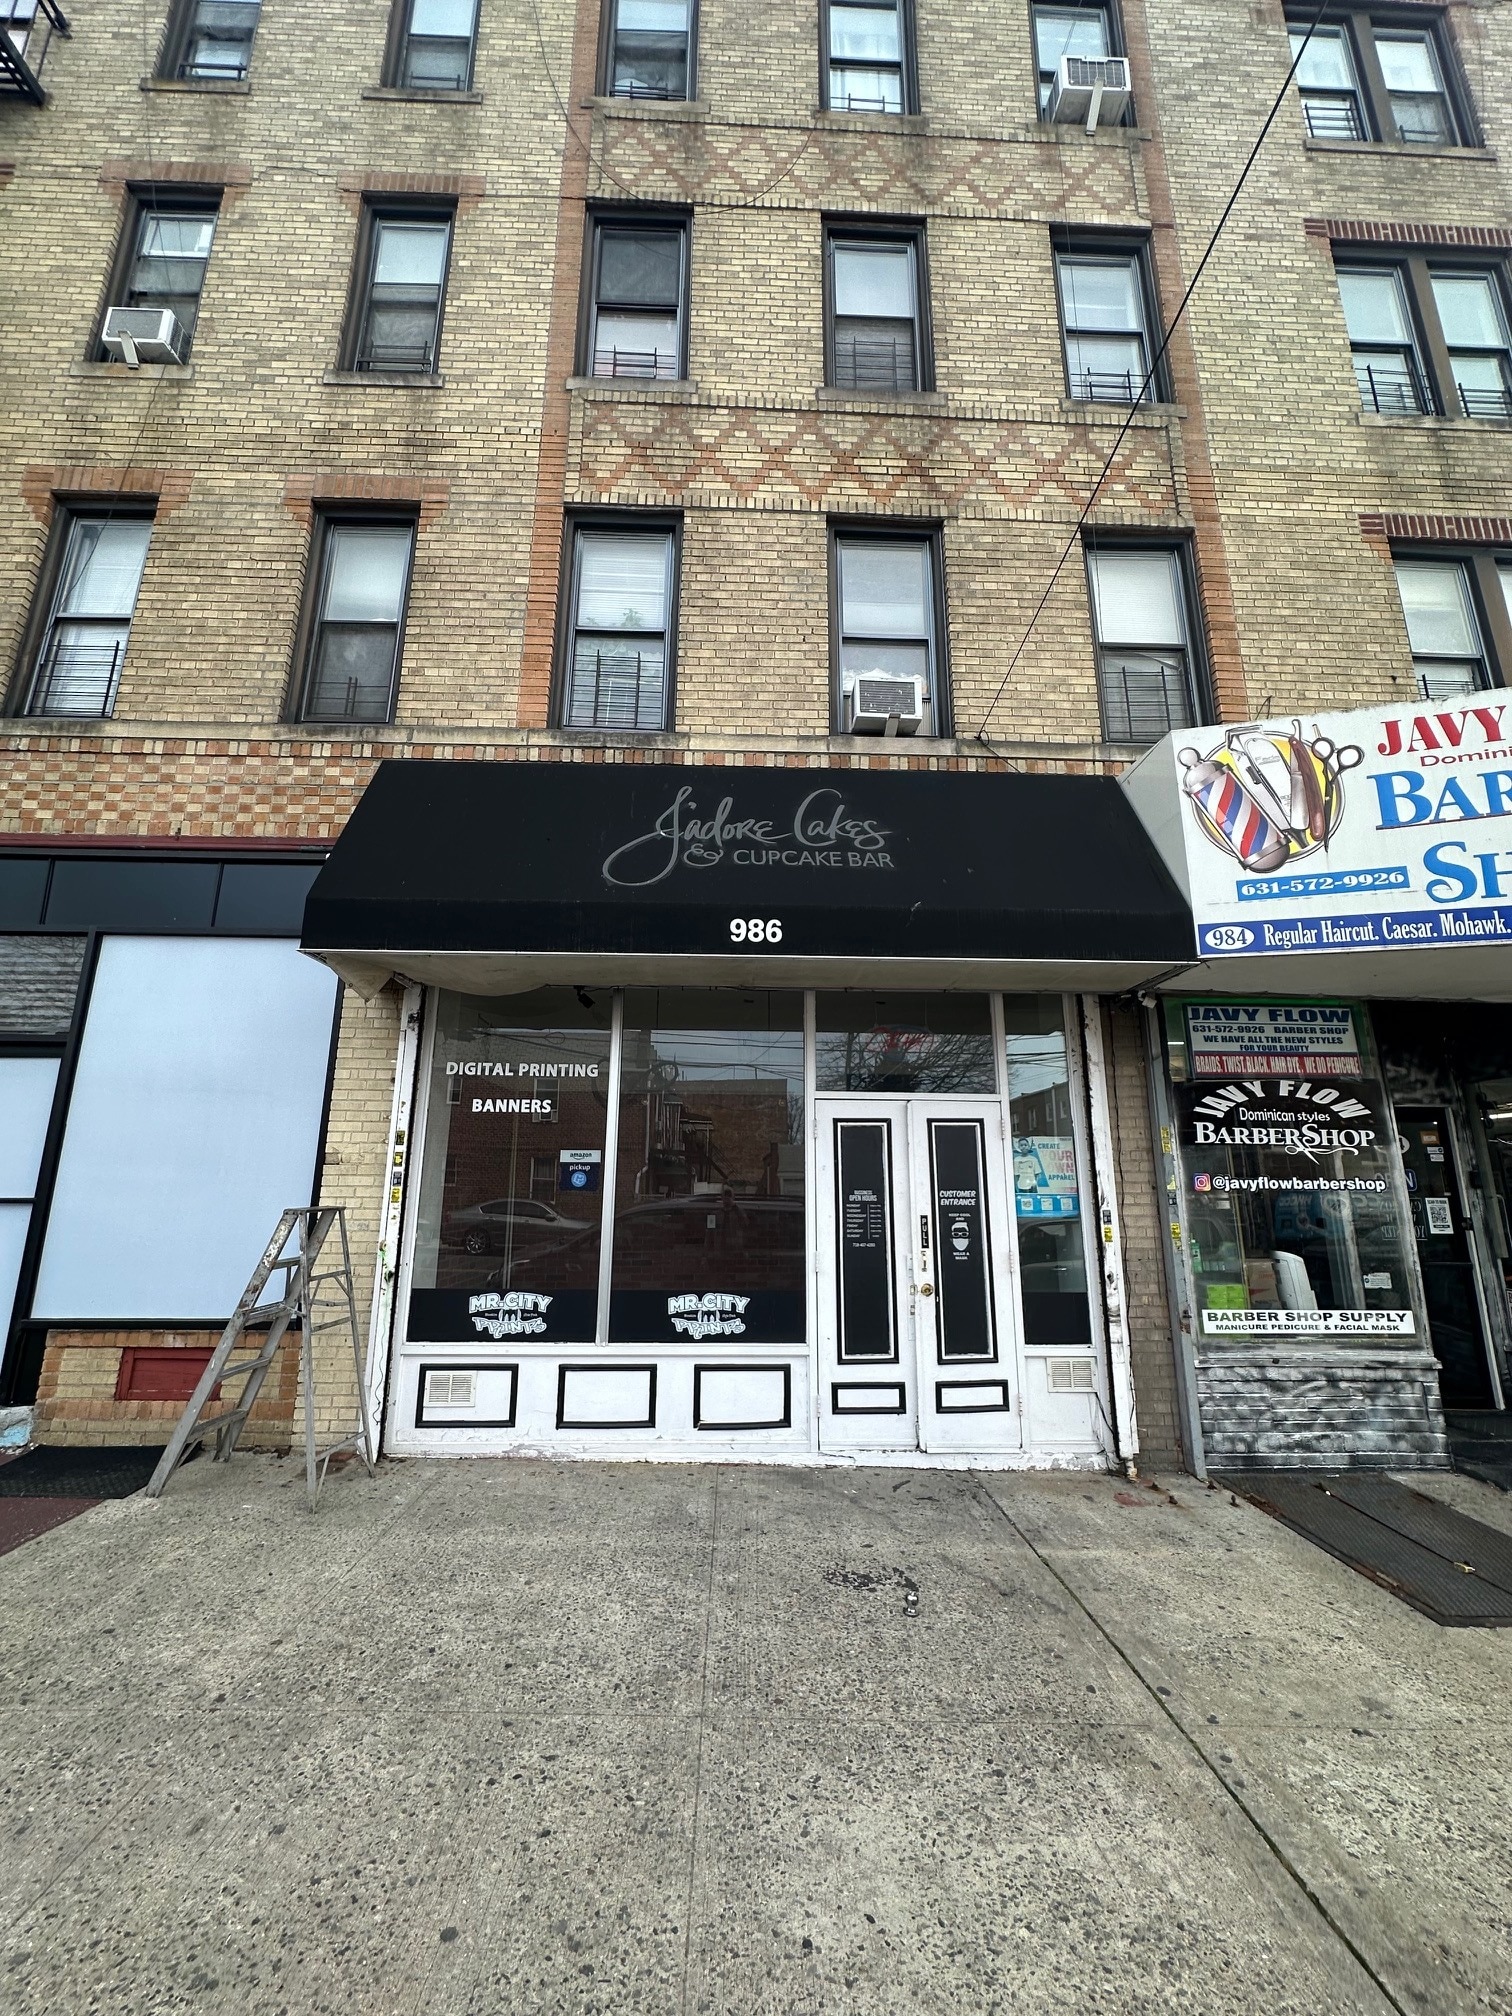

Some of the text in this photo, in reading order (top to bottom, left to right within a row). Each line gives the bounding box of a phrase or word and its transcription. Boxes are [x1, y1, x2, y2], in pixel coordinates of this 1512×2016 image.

[1377, 705, 1507, 756] JAVY
[794, 788, 893, 850] Cakes
[683, 843, 895, 868] & CUPCAKE BAR
[1241, 871, 1405, 896] 631-572-9926
[730, 919, 783, 943] 986
[1212, 911, 1512, 949] 984 Regular Haircut. Caesar. Mohawk.
[1190, 1007, 1350, 1023] JAVY FLOW
[1192, 1025, 1349, 1035] 631-572-9926 BARBER SHOP
[1203, 1035, 1343, 1045] WE HAVE ALL THE NEW STYLES
[446, 1061, 599, 1077] DIGITAL PRINTING
[1270, 1056, 1287, 1073] HAIR
[1305, 1057, 1317, 1073] WE
[1317, 1057, 1327, 1073] DO
[472, 1099, 551, 1113] BANNERS
[1193, 1080, 1372, 1118] JAVY FLOW
[1239, 1107, 1331, 1123] Dominican styles
[1212, 1175, 1386, 1192] @javyflowbarbershop
[1207, 1312, 1406, 1322] BARBER SHOP SUPPLY
